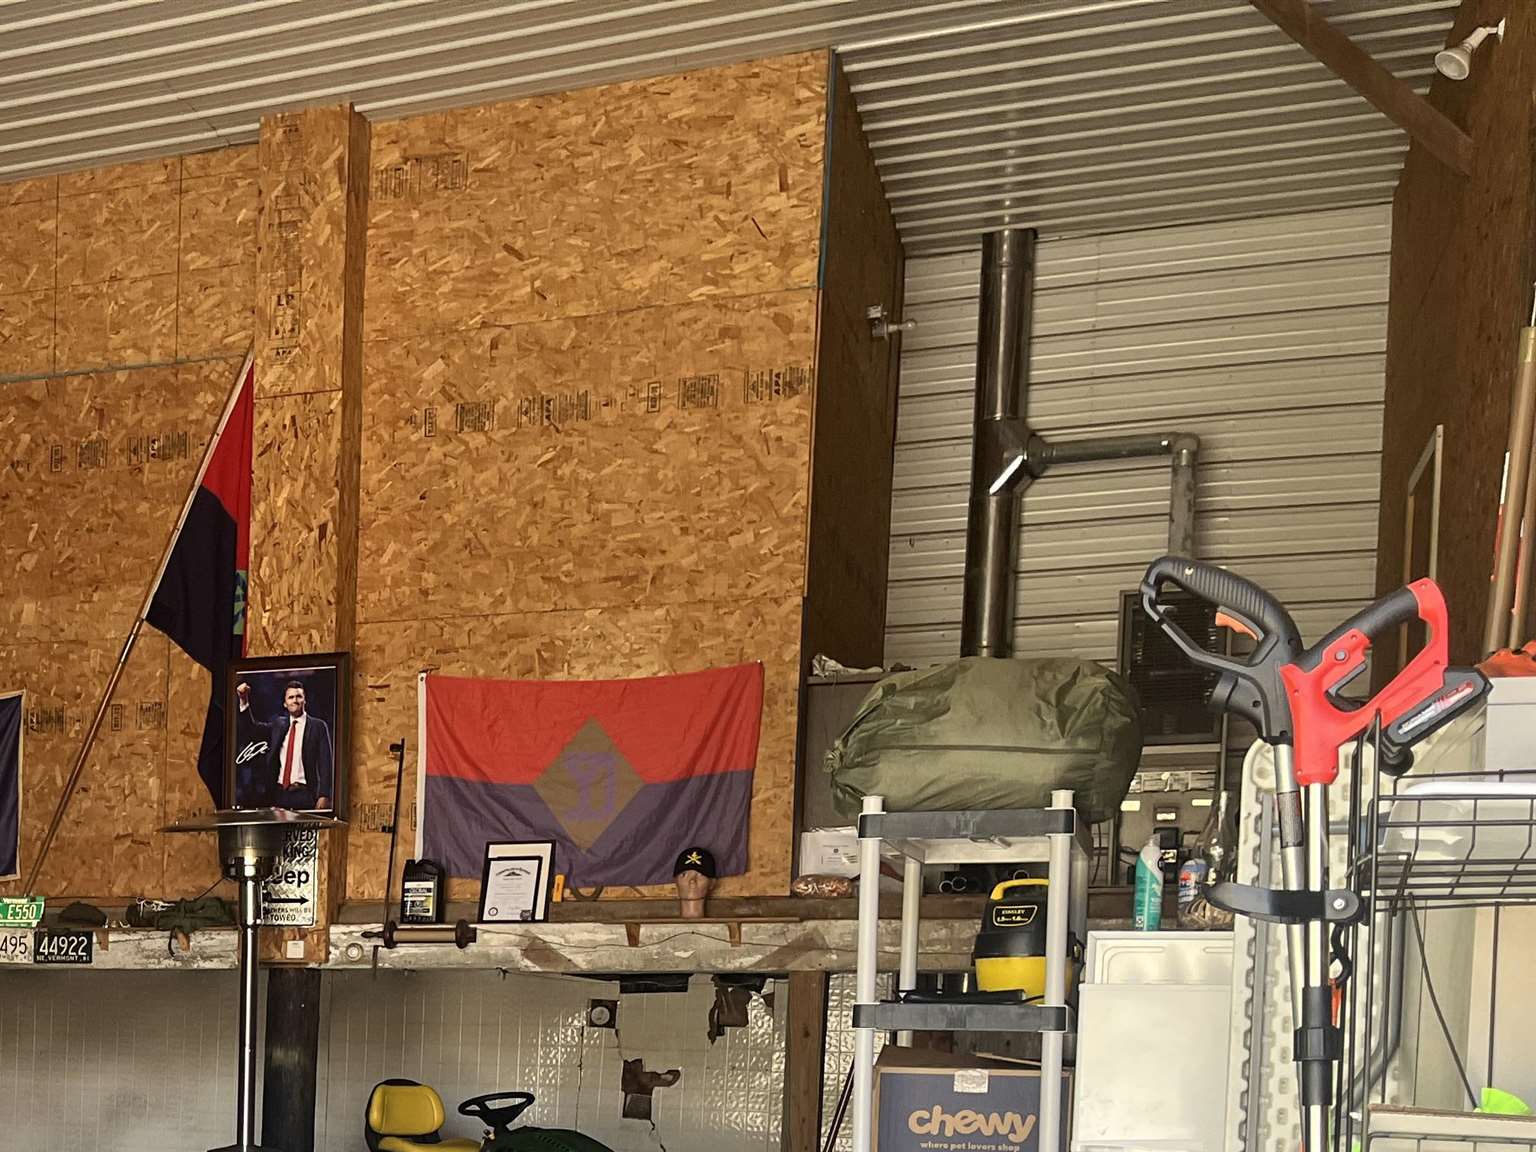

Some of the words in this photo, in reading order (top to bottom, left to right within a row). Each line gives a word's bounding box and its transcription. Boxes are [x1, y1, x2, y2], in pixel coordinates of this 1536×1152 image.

[283, 845, 309, 858] KING
[7, 904, 37, 920] E550
[39, 936, 88, 956] 44922
[908, 1104, 1036, 1143] chewy
[919, 1141, 949, 1150] where
[950, 1141, 966, 1151] pet
[967, 1141, 996, 1152] lovers
